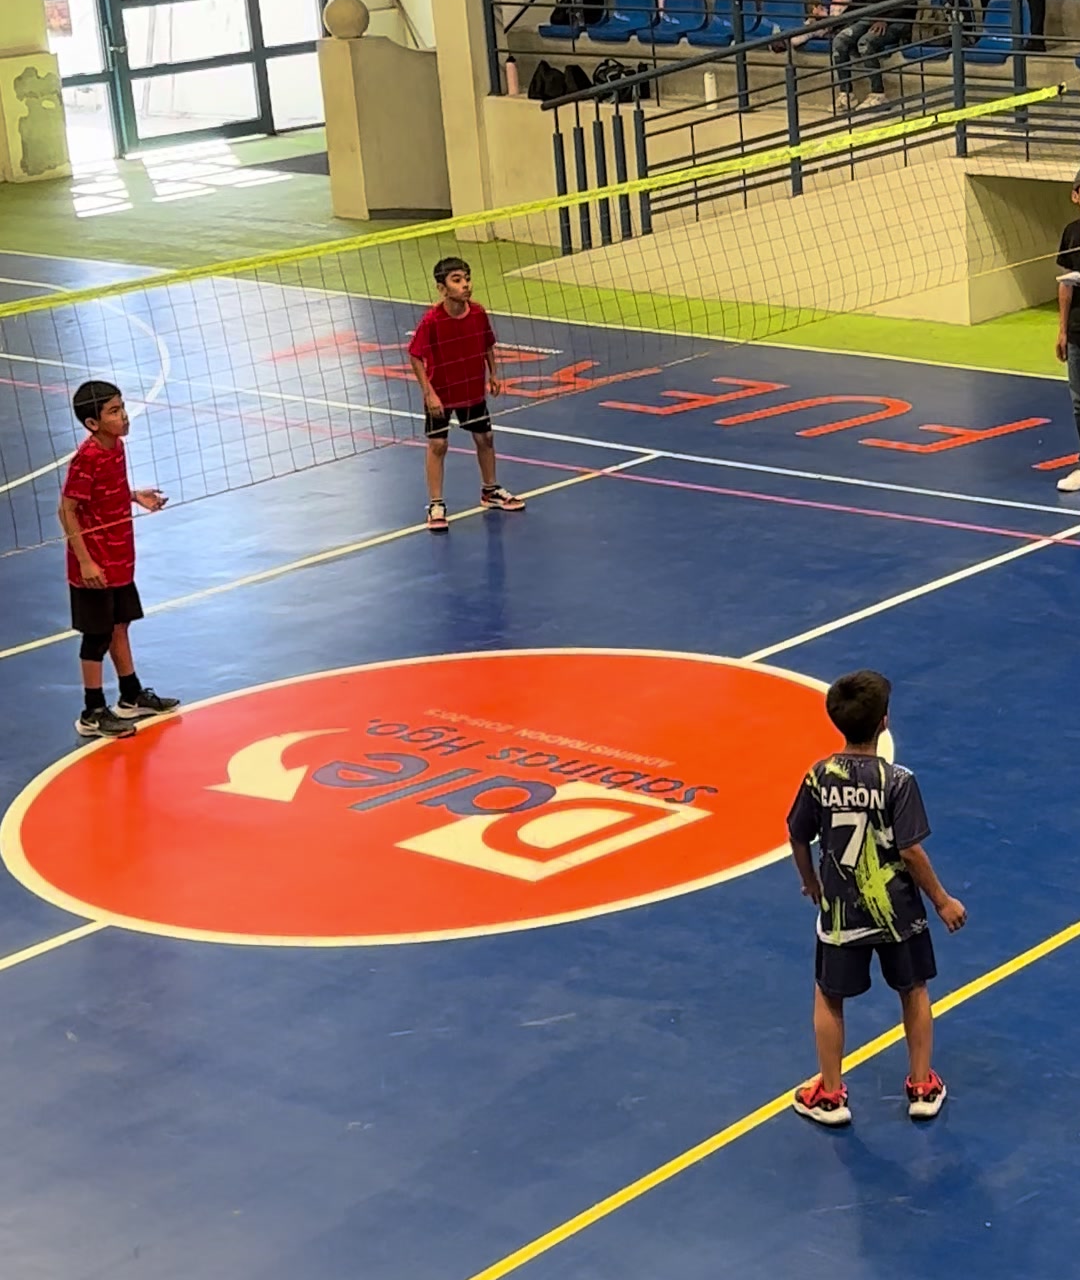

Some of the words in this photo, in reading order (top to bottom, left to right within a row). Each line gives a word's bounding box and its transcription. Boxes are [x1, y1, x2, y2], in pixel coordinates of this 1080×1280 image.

[367, 718, 486, 756] Hgo.
[311, 752, 682, 862] Dale
[831, 812, 867, 868] 7
